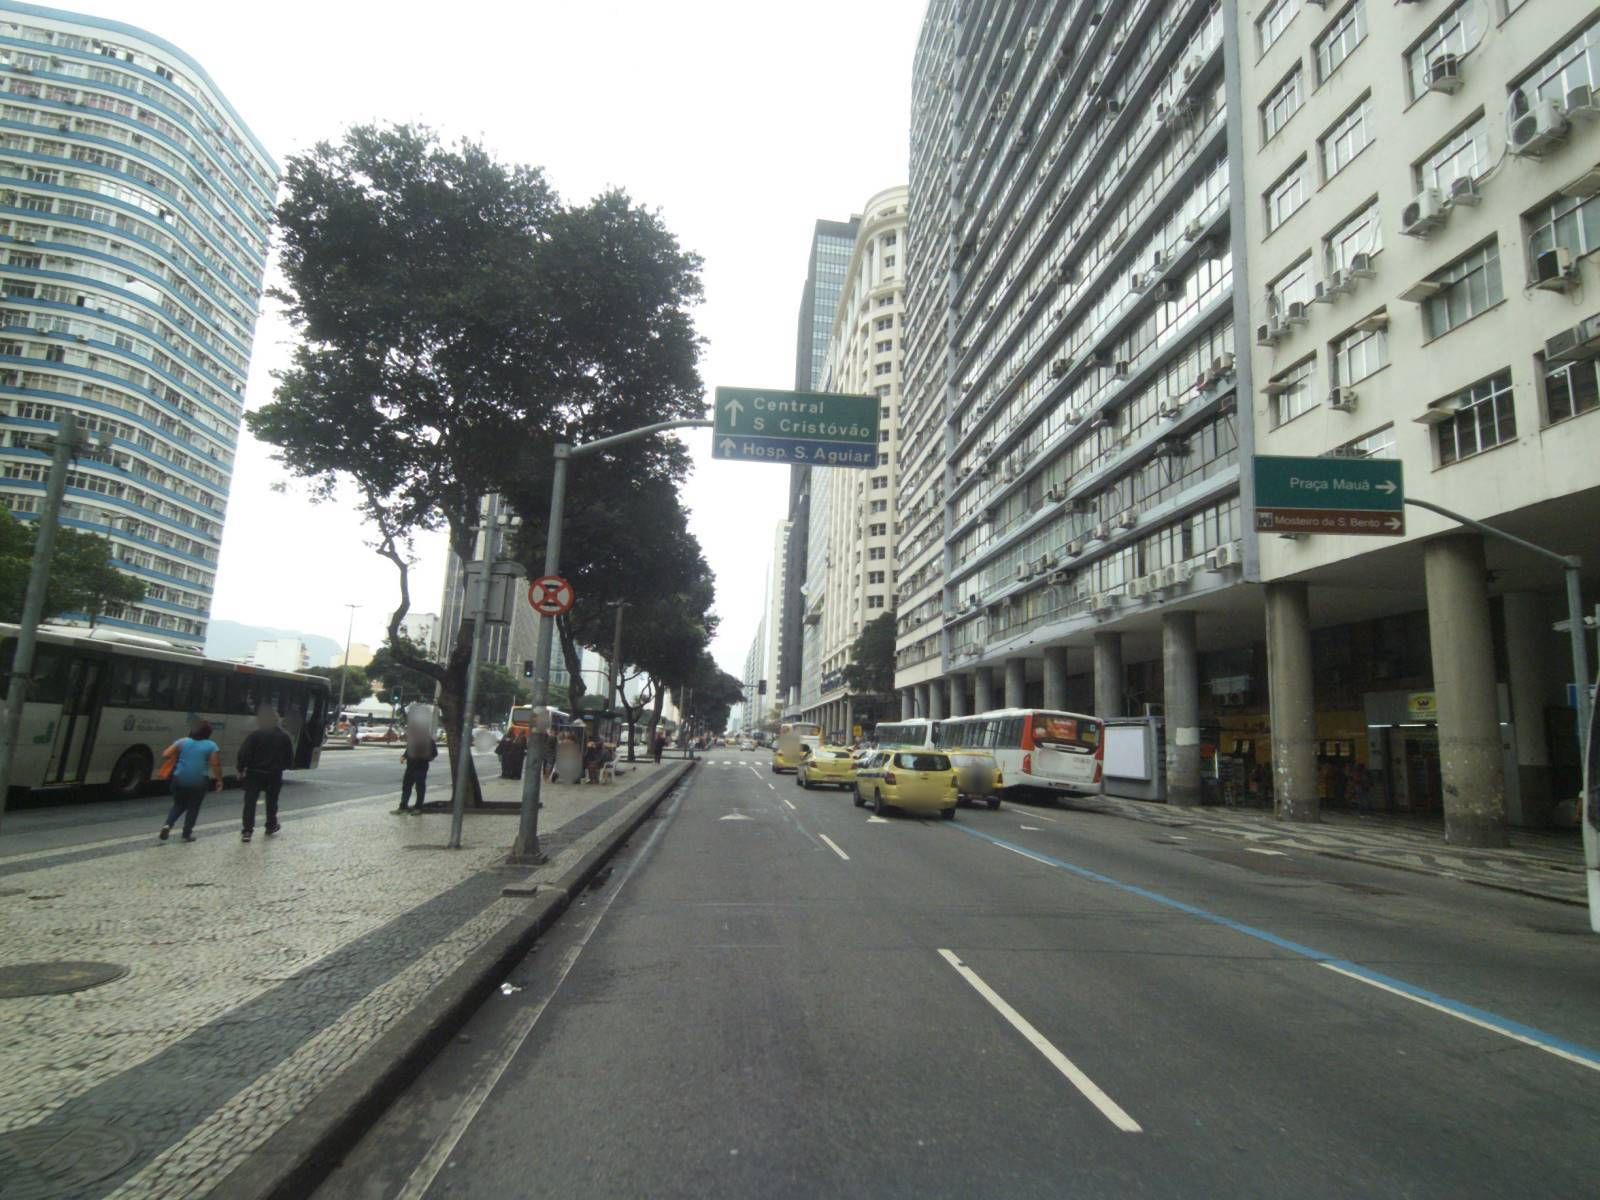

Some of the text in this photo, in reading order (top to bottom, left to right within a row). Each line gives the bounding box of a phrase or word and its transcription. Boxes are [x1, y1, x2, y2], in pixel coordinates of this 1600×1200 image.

[753, 397, 824, 414] Central
[779, 418, 870, 438] Cristóvão
[814, 447, 871, 463] Aguiar
[1290, 477, 1370, 491] Praça Mauá
[1275, 515, 1320, 527] Mosteiro
[1350, 518, 1380, 528] Bento
